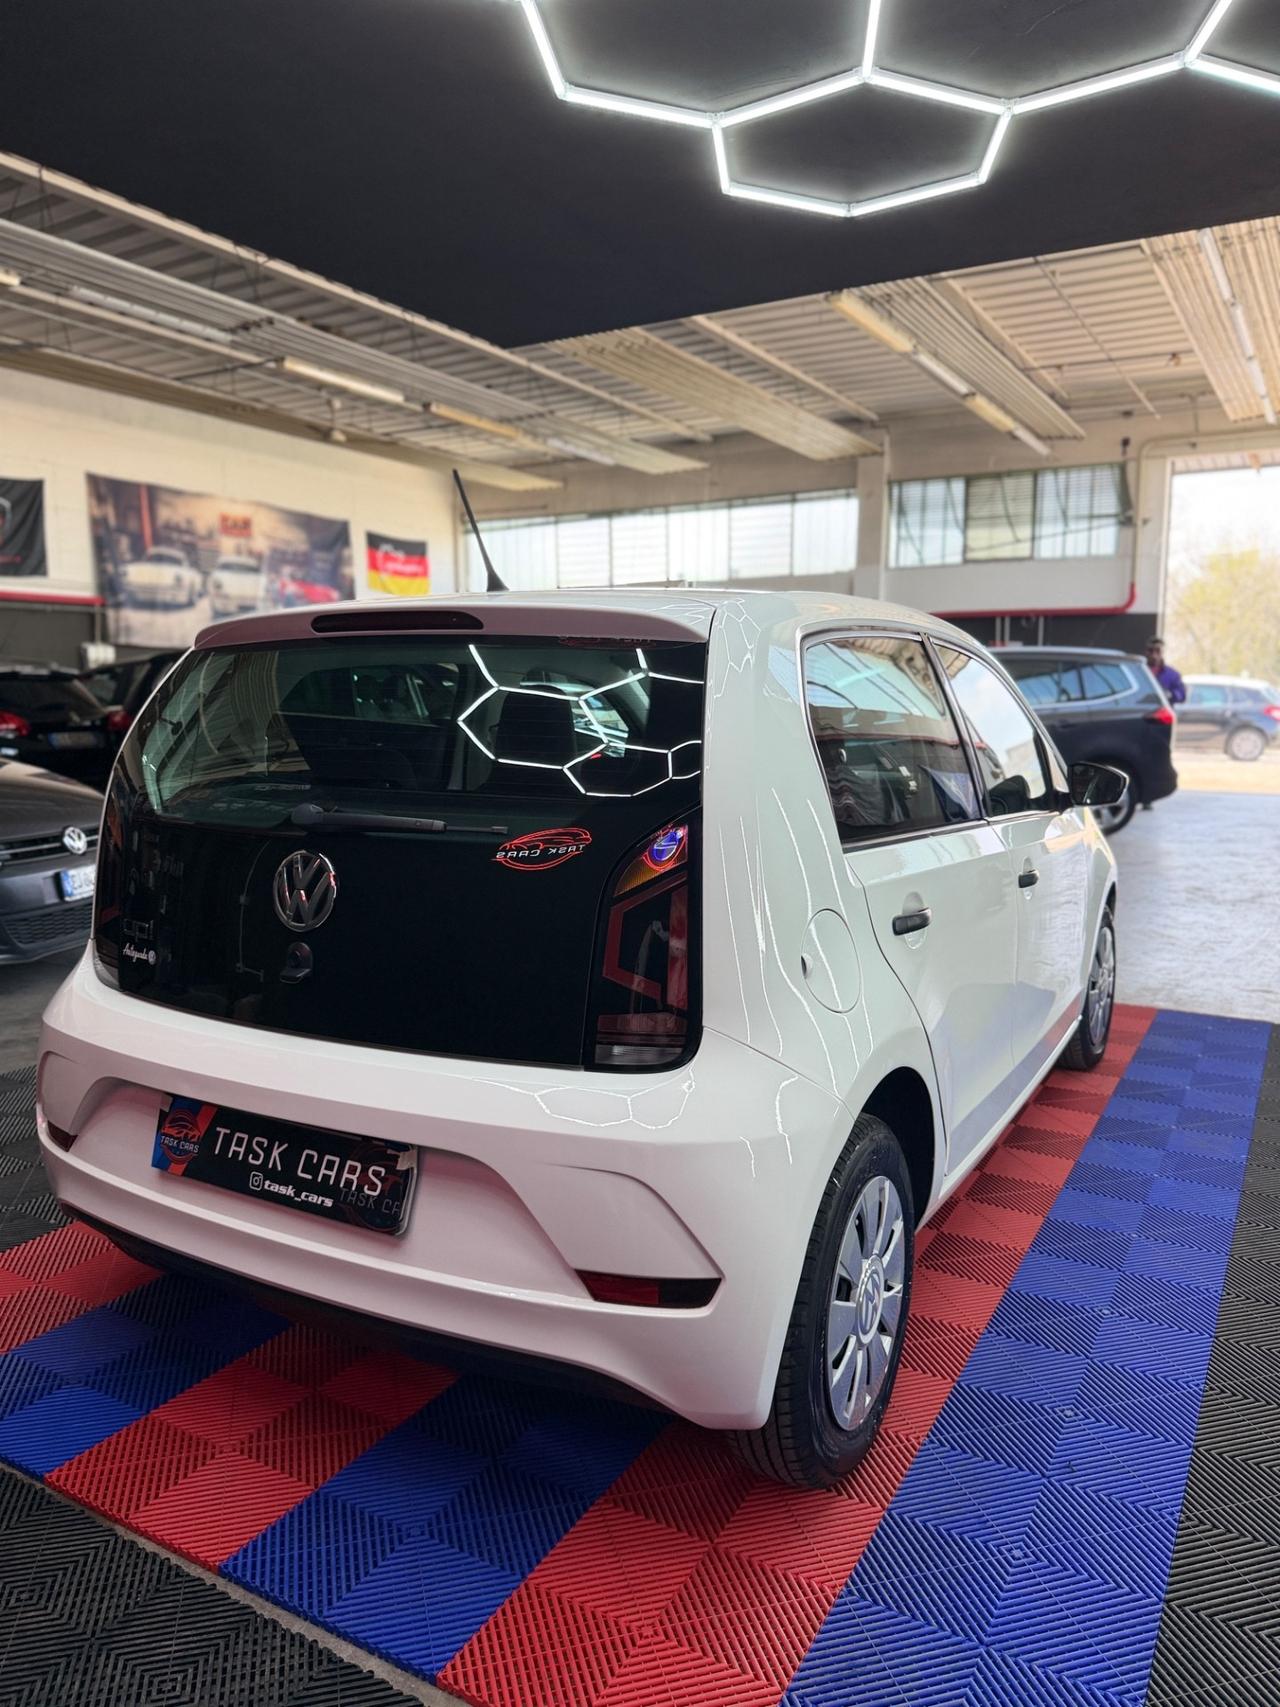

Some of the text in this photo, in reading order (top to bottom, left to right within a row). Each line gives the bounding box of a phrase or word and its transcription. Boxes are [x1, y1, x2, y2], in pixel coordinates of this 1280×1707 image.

[274, 851, 336, 932] VW
[161, 1135, 200, 1153] TASK CARS
[214, 1127, 386, 1196] TASK CARS
[264, 1179, 334, 1208] task_cars
[340, 1187, 377, 1209] TASK
